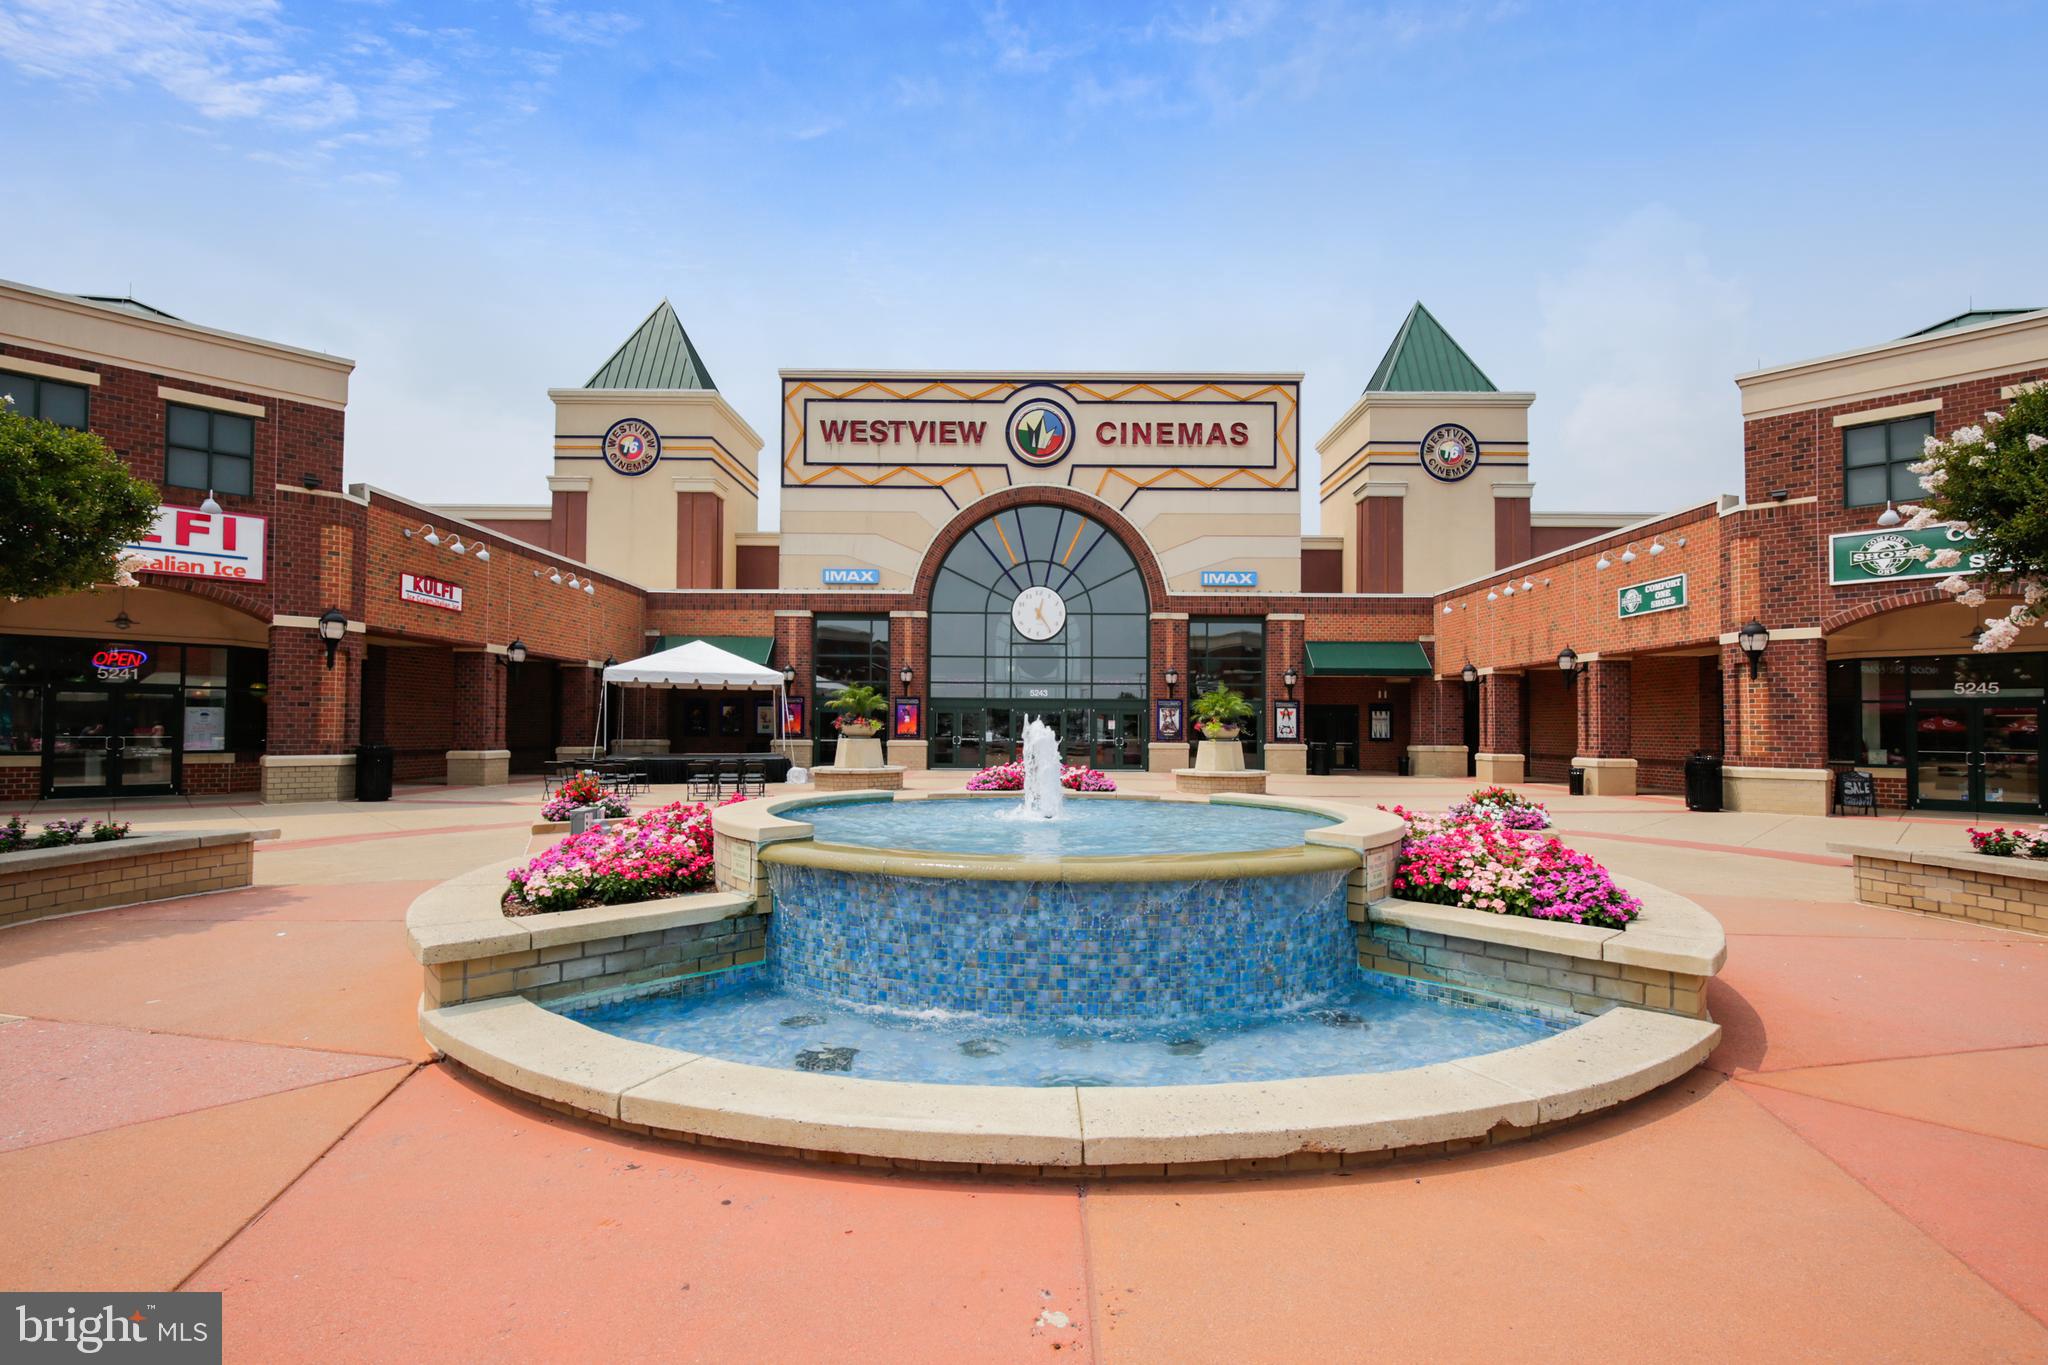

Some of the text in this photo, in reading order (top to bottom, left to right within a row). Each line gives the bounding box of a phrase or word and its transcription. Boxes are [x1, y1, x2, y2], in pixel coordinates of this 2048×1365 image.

[819, 420, 1249, 446] WESTVIEW CINEMAS
[622, 441, 639, 454] 16
[1426, 429, 1475, 454] WESTVIEW
[610, 453, 653, 471] CINEMAS
[1428, 458, 1472, 477] CINEMAS
[1853, 548, 1912, 563] SHOE
[213, 561, 247, 577] Ice
[825, 570, 874, 582] IMAX
[1204, 573, 1253, 584] IMAX
[413, 576, 454, 599] KULFI
[92, 651, 142, 667] OPEN
[97, 667, 138, 680] 5241
[1030, 689, 1048, 697] 5243
[1953, 682, 2000, 695] 5245
[1844, 781, 1871, 795] SALE
